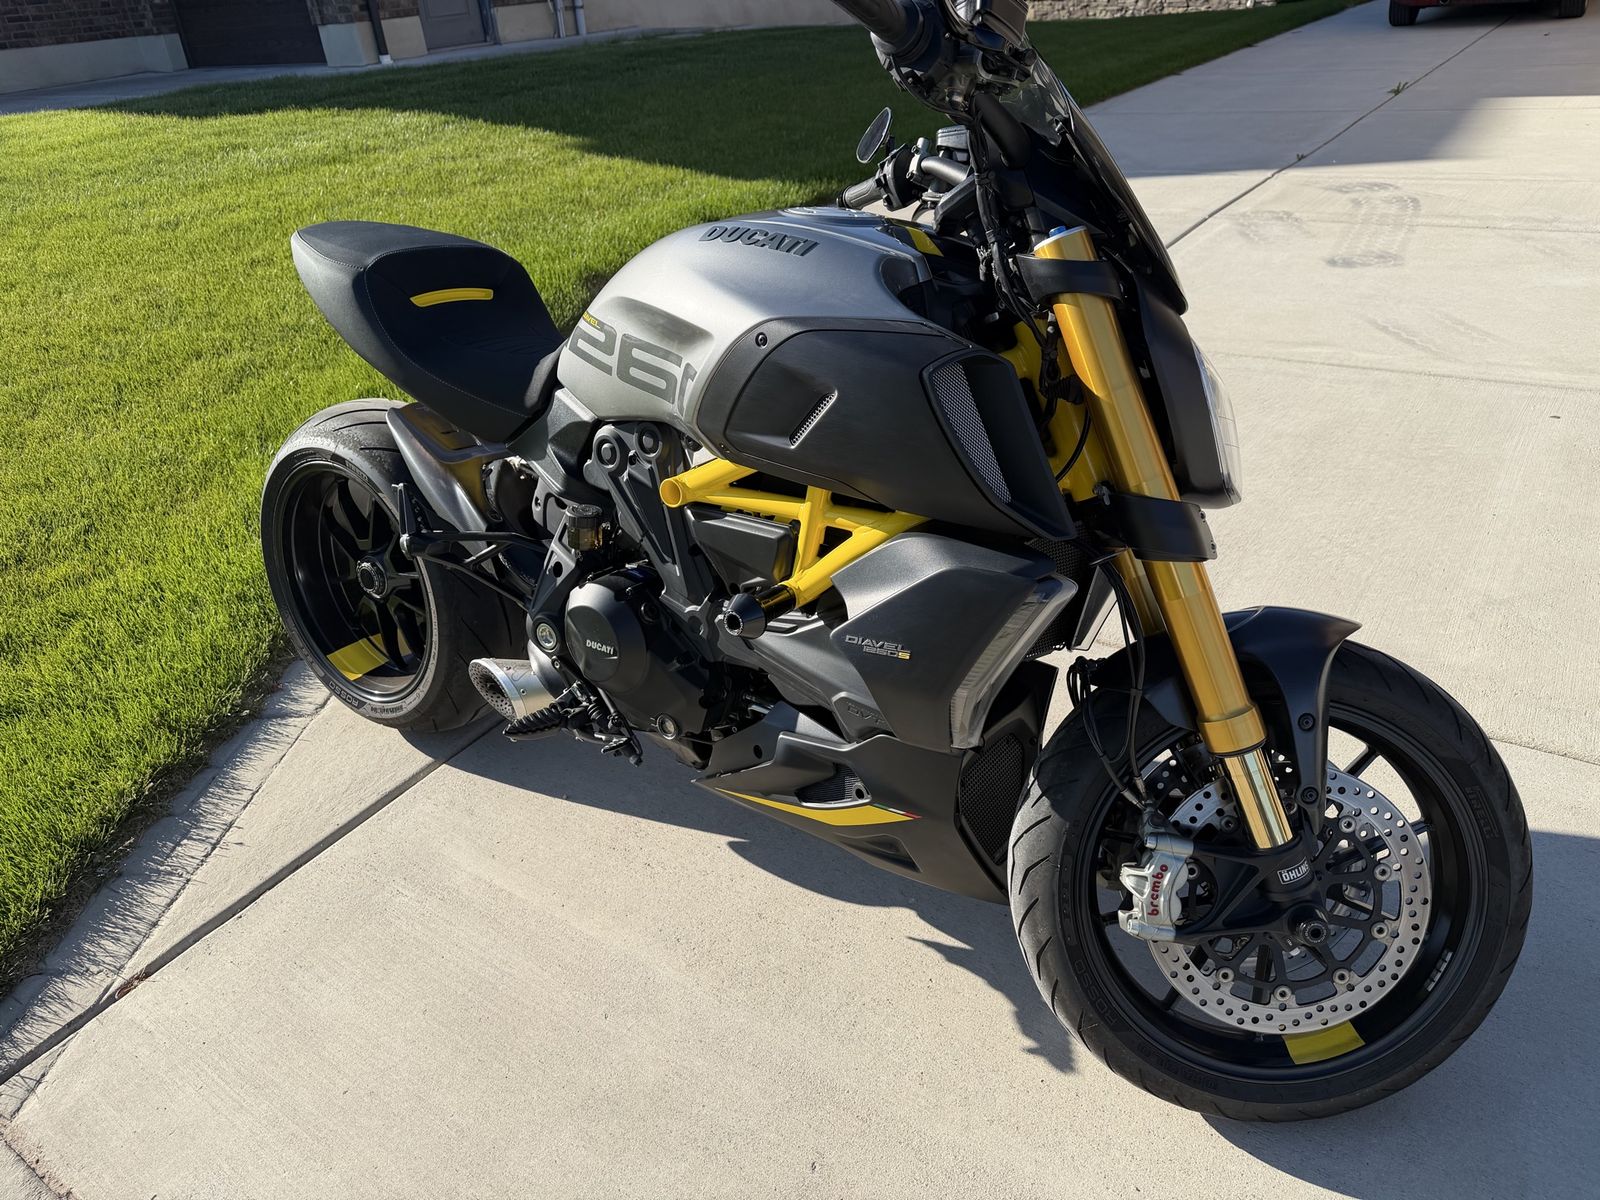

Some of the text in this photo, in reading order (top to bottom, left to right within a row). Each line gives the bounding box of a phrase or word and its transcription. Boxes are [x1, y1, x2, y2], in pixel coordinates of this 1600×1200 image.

[699, 226, 820, 256] DUCATI
[586, 639, 614, 655] DUCATI
[845, 634, 911, 653] DIAVEL
[329, 681, 359, 707] ROSSO
[1281, 860, 1309, 882] ÖHLINS
[1148, 864, 1168, 916] brembo
[1074, 960, 1119, 1024] ROSSO
